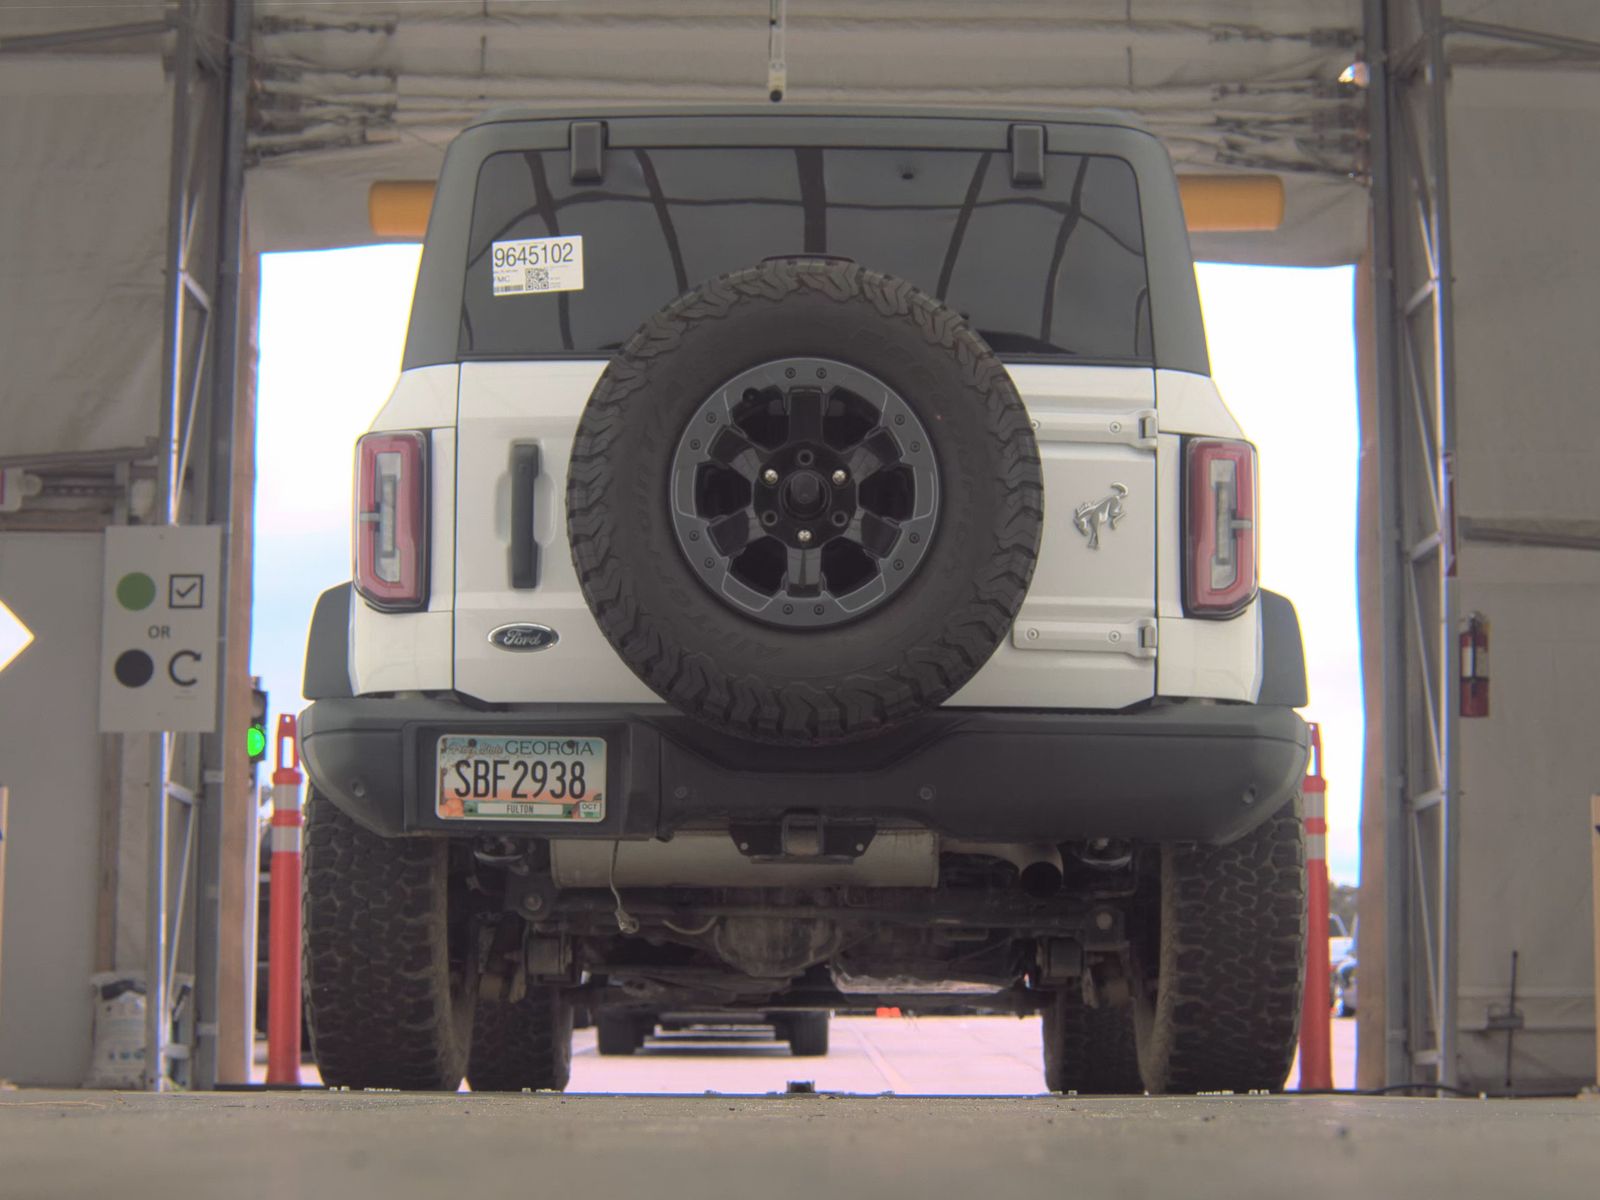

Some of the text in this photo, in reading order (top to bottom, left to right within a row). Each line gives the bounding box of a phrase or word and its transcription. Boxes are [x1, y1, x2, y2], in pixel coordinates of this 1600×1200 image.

[494, 242, 573, 267] 9645102
[148, 625, 171, 639] OR
[503, 628, 542, 646] Ford
[504, 740, 594, 755] GEORGIA
[454, 759, 586, 799] SBF2938
[506, 805, 534, 814] FULTON
[581, 803, 598, 811] OCT
